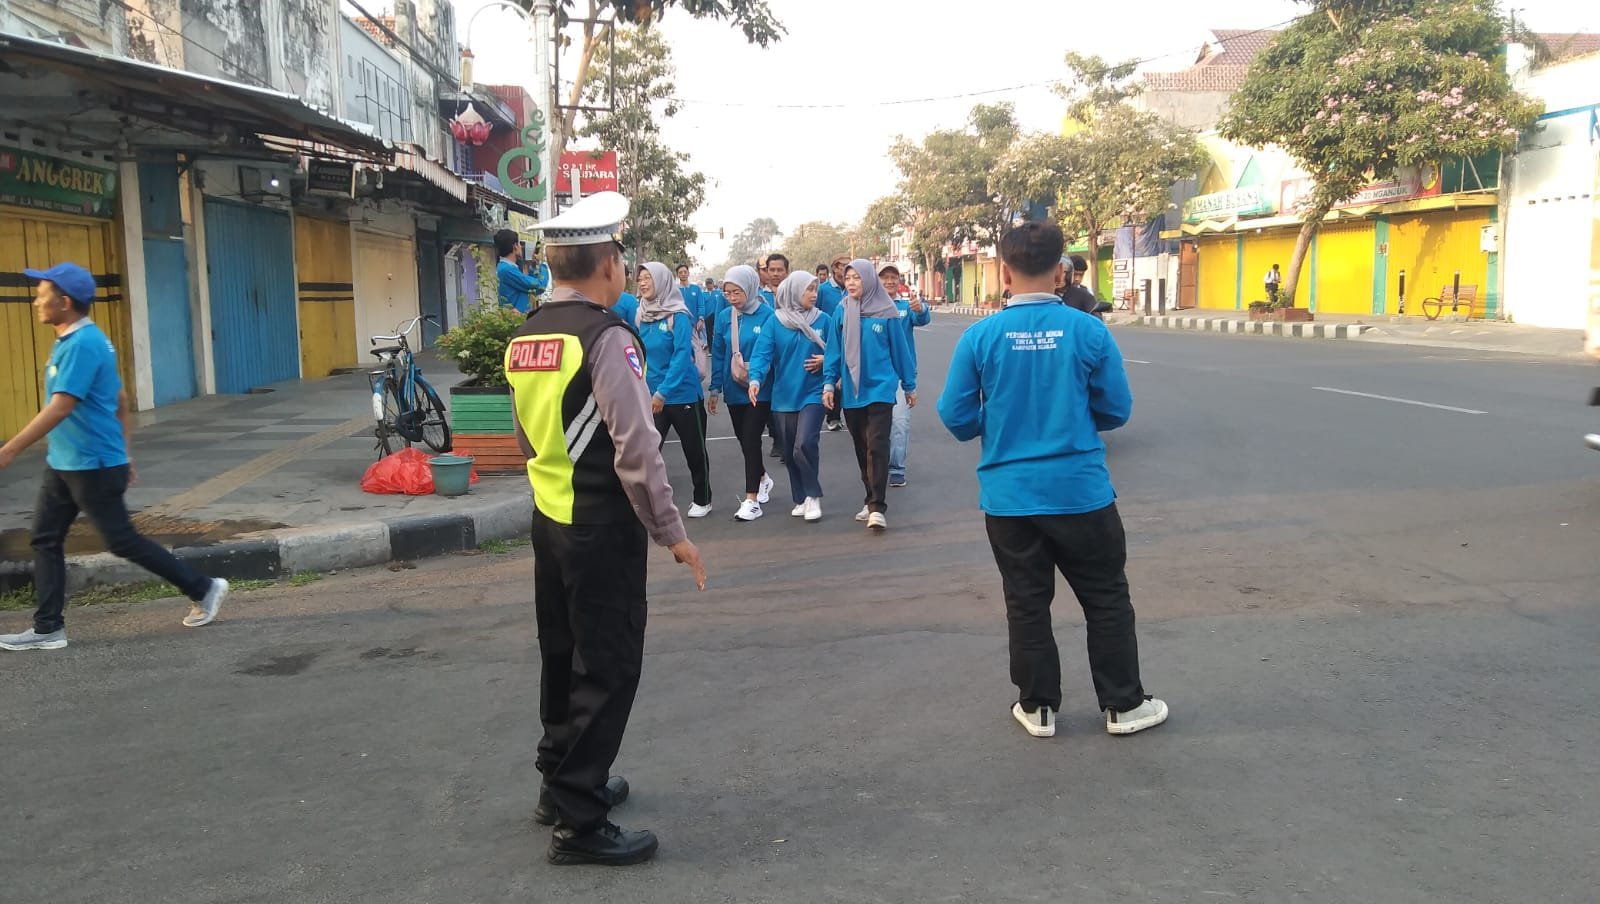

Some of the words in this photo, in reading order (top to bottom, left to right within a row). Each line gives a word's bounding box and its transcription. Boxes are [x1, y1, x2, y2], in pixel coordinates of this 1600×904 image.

[15, 156, 104, 195] ANGGREK
[562, 170, 616, 180] SUDARA
[1373, 187, 1408, 199] NGANJUK
[510, 342, 560, 369] POLISI
